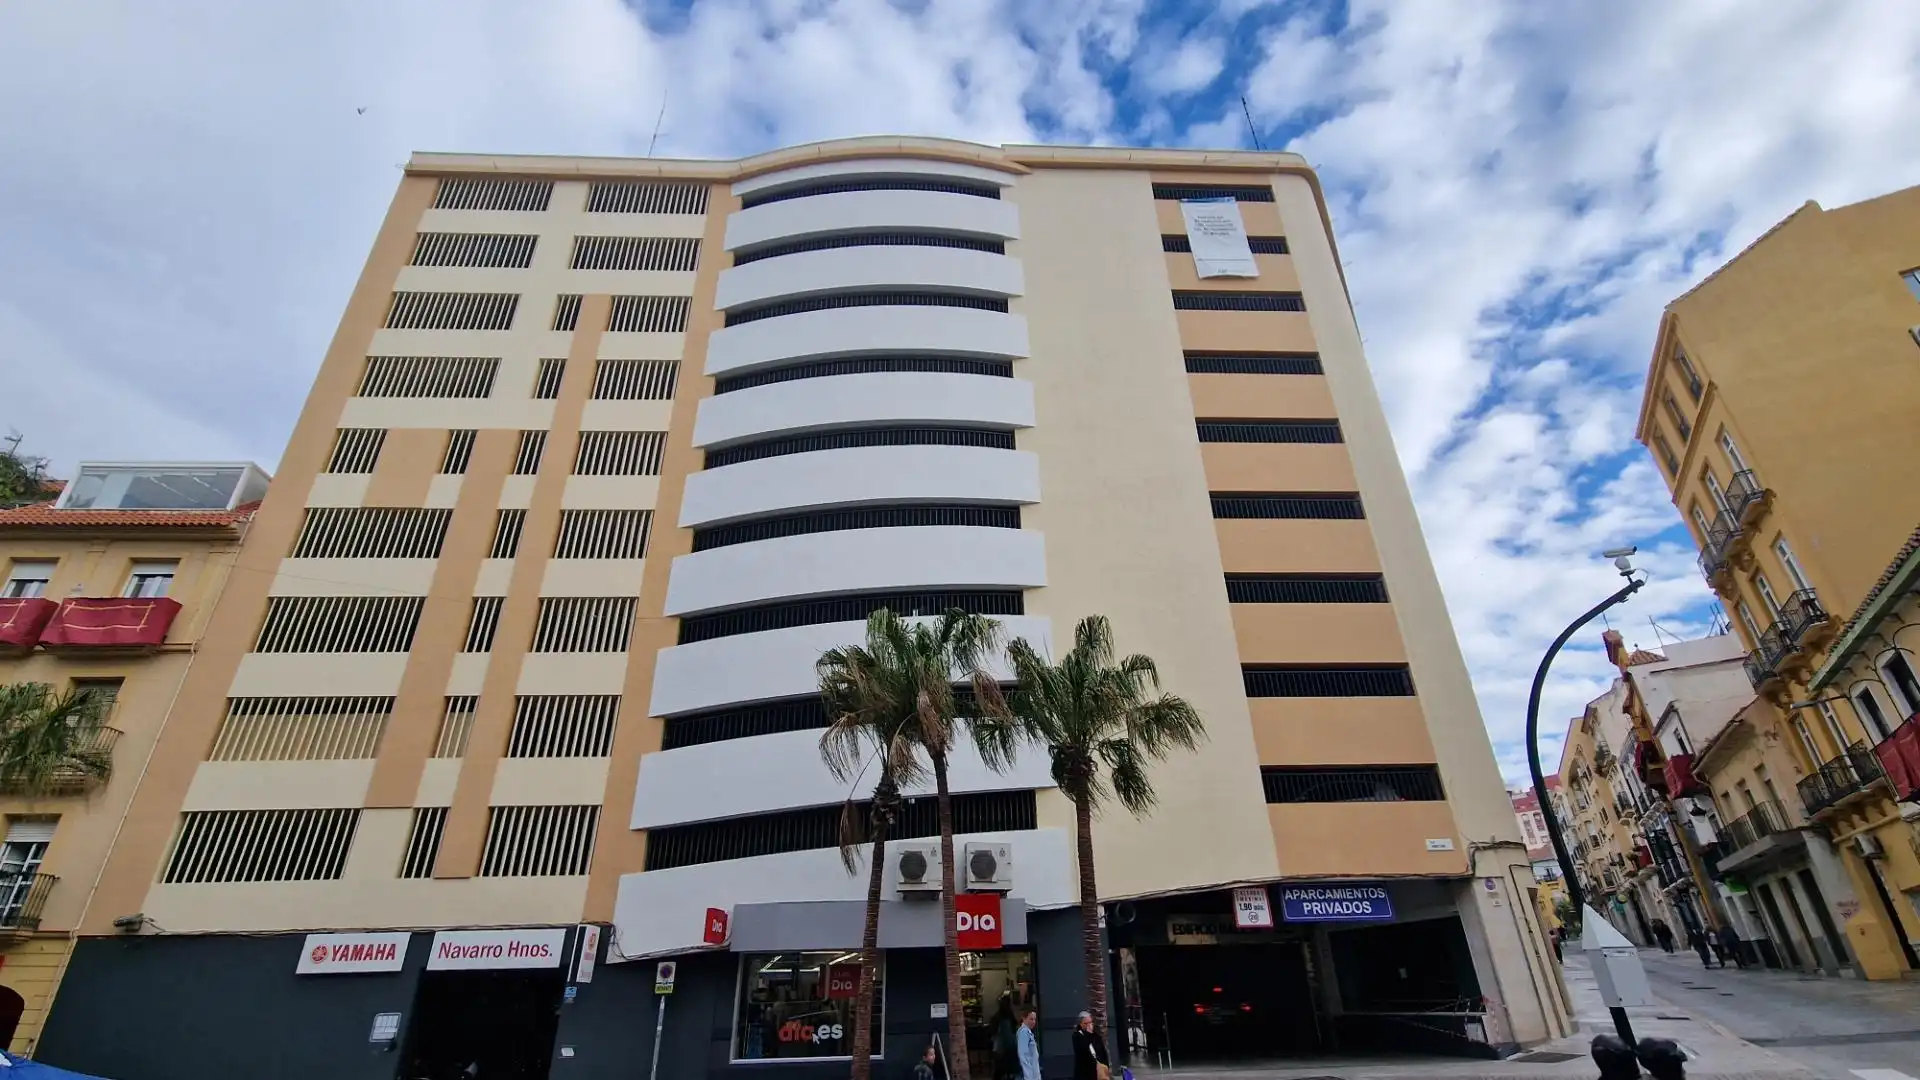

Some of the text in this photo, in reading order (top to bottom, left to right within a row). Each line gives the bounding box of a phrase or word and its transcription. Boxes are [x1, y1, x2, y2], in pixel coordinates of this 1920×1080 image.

[1285, 887, 1385, 900] APARCAMIENTOS
[1302, 901, 1372, 915] PRIVADOS
[331, 943, 396, 962] YAMAHA
[438, 940, 553, 961] Navarro Hnos.
